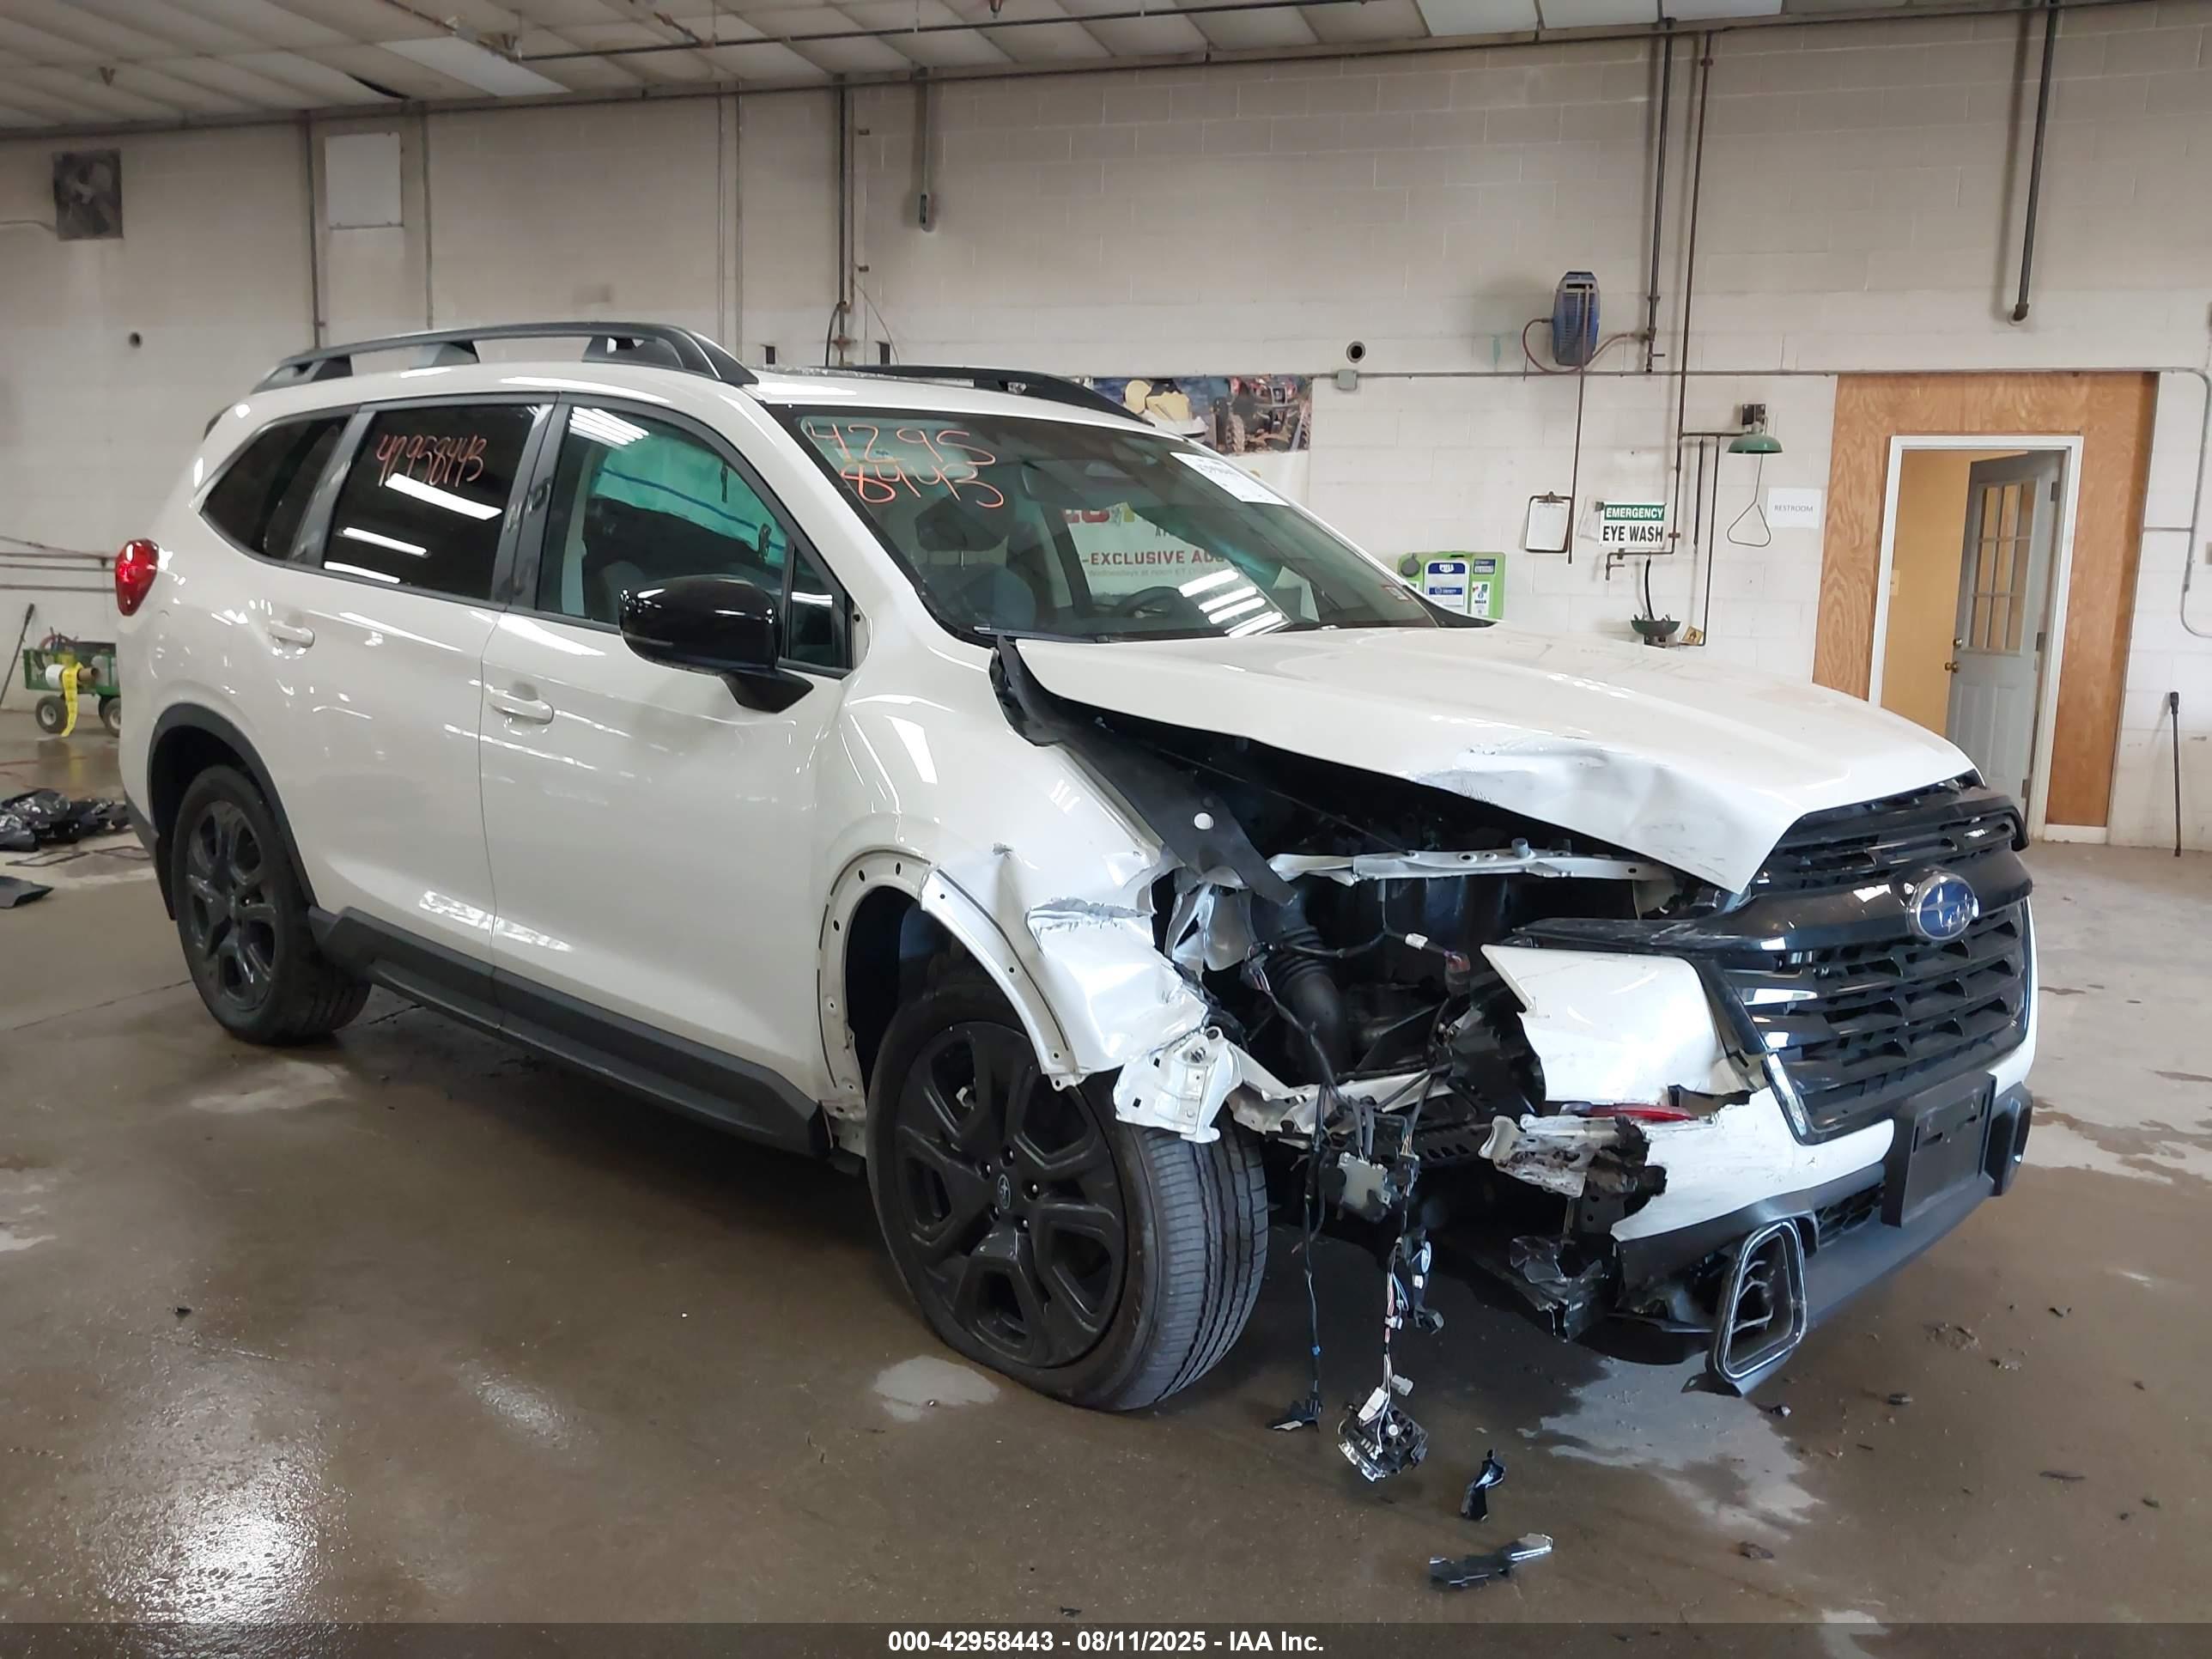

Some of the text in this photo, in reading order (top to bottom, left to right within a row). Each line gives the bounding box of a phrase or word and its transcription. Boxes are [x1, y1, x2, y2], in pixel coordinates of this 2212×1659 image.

[807, 421, 996, 465] 4295
[375, 434, 488, 488] 42958443
[839, 463, 1005, 508] 8443
[1606, 507, 1664, 520] EMERGENCY
[1773, 504, 1814, 513] RESTROOM
[1602, 525, 1664, 543] EYE WASH
